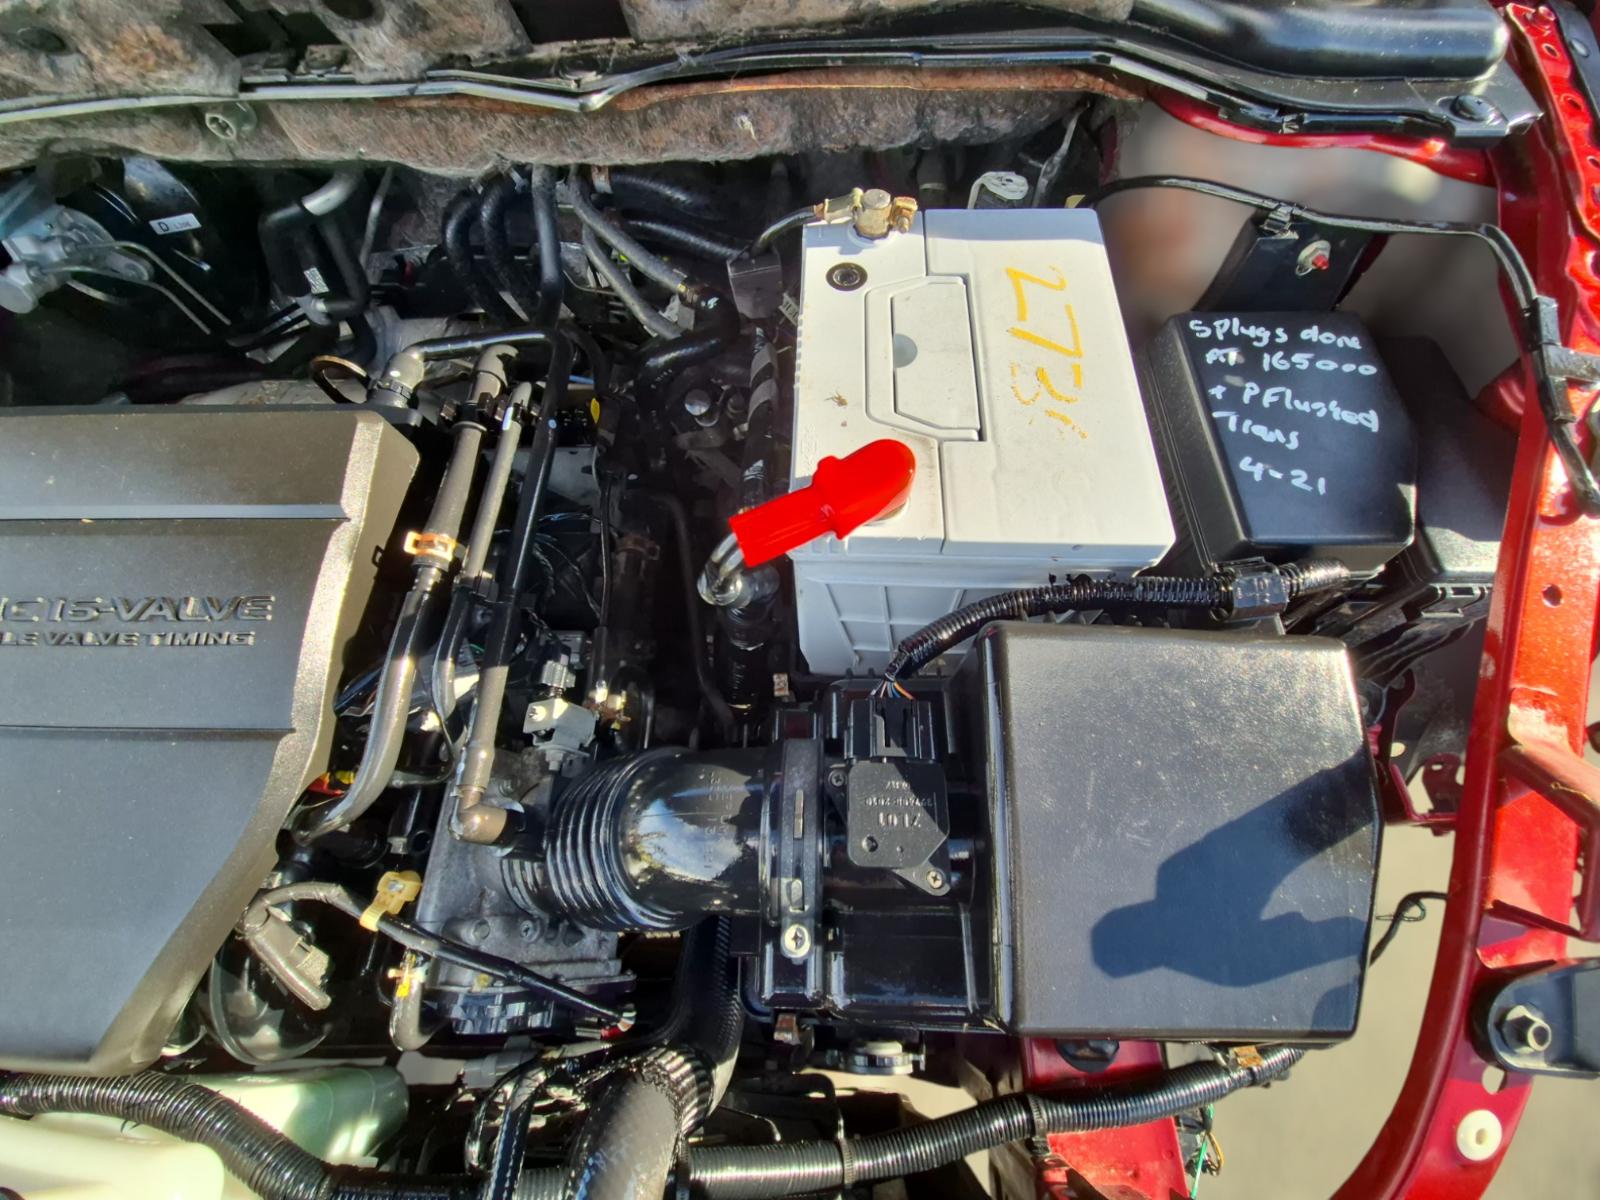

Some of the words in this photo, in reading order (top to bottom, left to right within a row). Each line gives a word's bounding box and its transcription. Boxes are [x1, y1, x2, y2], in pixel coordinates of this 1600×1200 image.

[1300, 325, 1362, 350] done
[1262, 351, 1377, 376] 165000
[1239, 456, 1326, 496] 4-21
[47, 596, 275, 622] 16-VALVE
[43, 631, 140, 647] VALVE
[141, 631, 255, 646] TIMING
